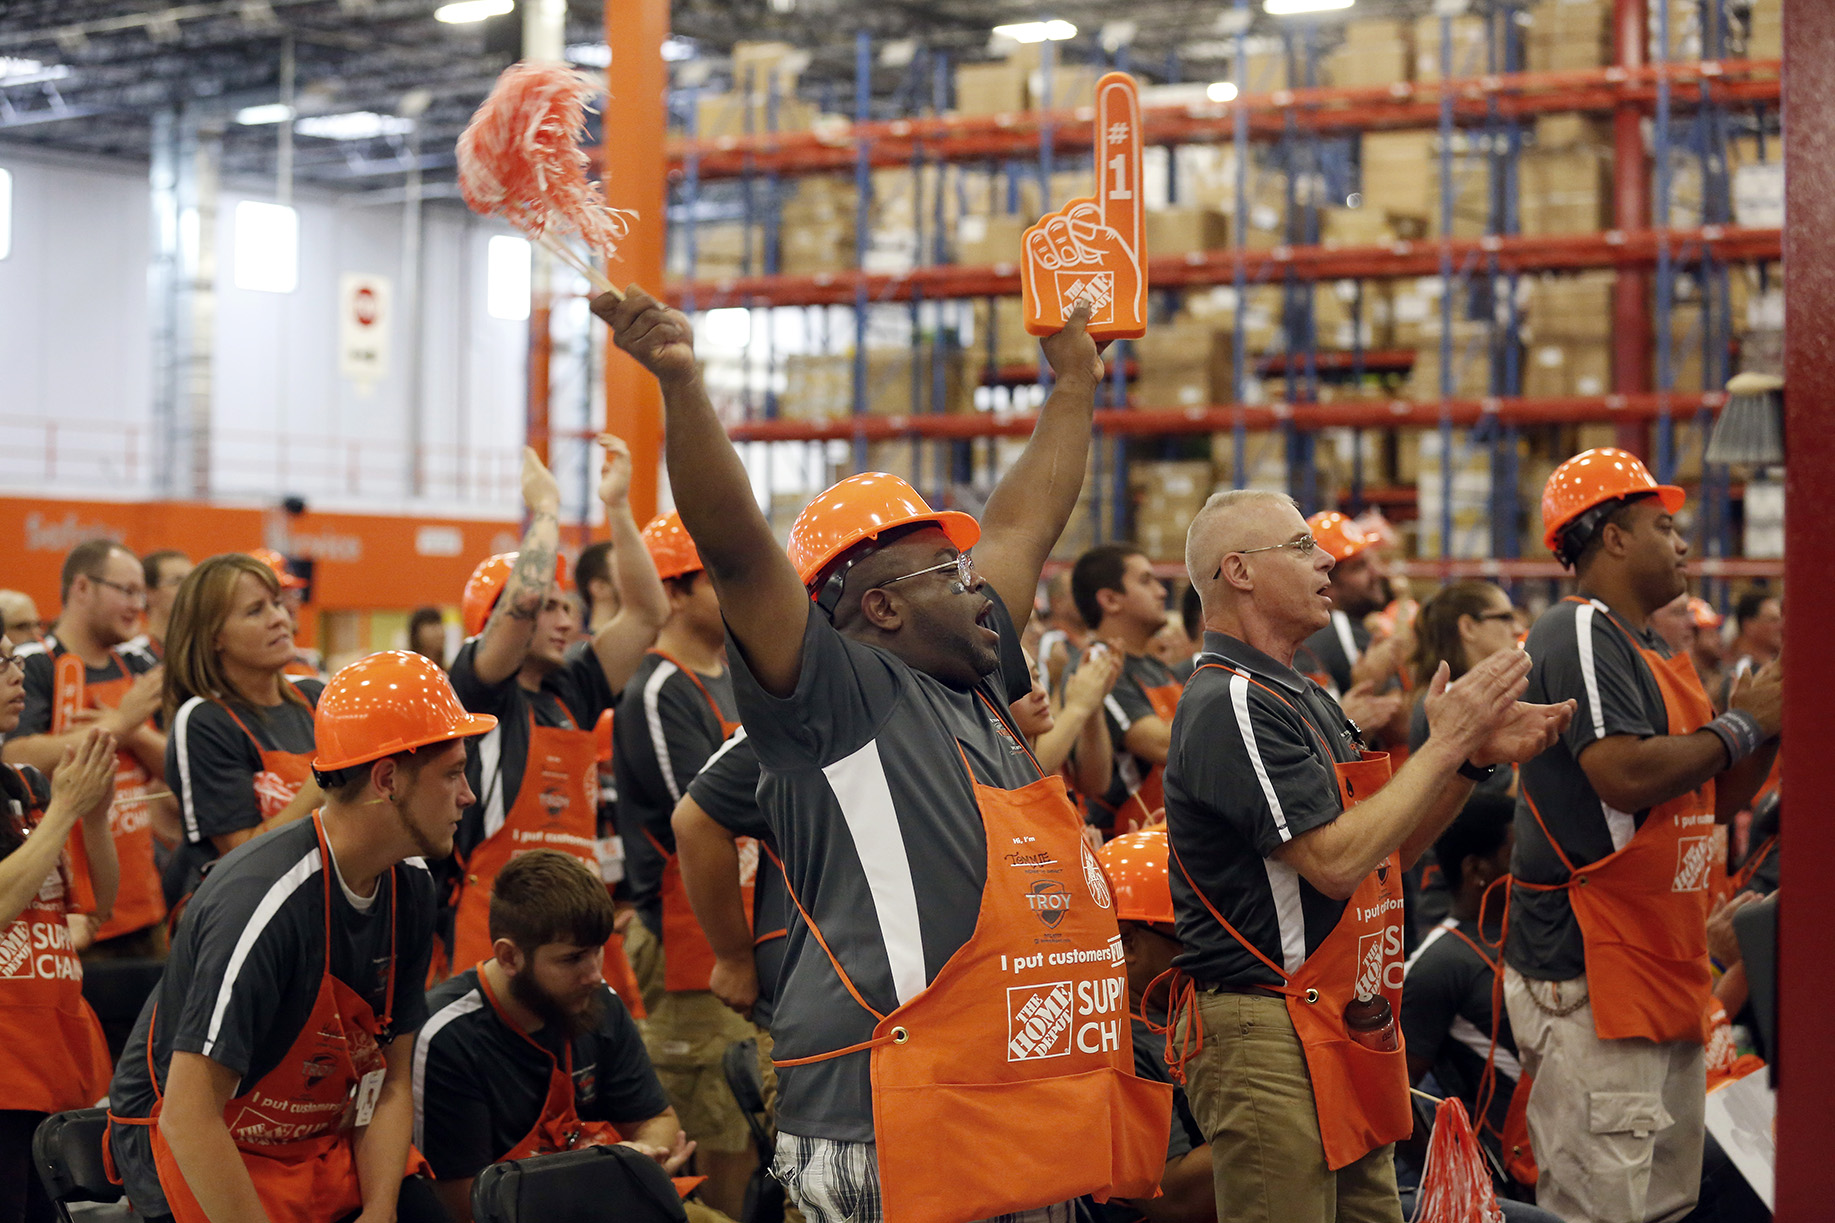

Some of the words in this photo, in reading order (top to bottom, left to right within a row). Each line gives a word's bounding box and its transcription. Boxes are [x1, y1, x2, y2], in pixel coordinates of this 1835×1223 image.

[1108, 153, 1133, 200] 1
[1063, 278, 1086, 302] THE
[1025, 893, 1072, 910] TROY
[1356, 907, 1362, 921] I
[1364, 904, 1380, 923] put
[1001, 955, 1008, 971] I
[1014, 952, 1044, 974] put
[1048, 948, 1112, 966] customers
[1009, 983, 1073, 1060] HOME
[1015, 993, 1044, 1024] THE
[1033, 1008, 1072, 1058] DEPOT
[252, 1091, 260, 1103] I
[262, 1099, 288, 1111] put
